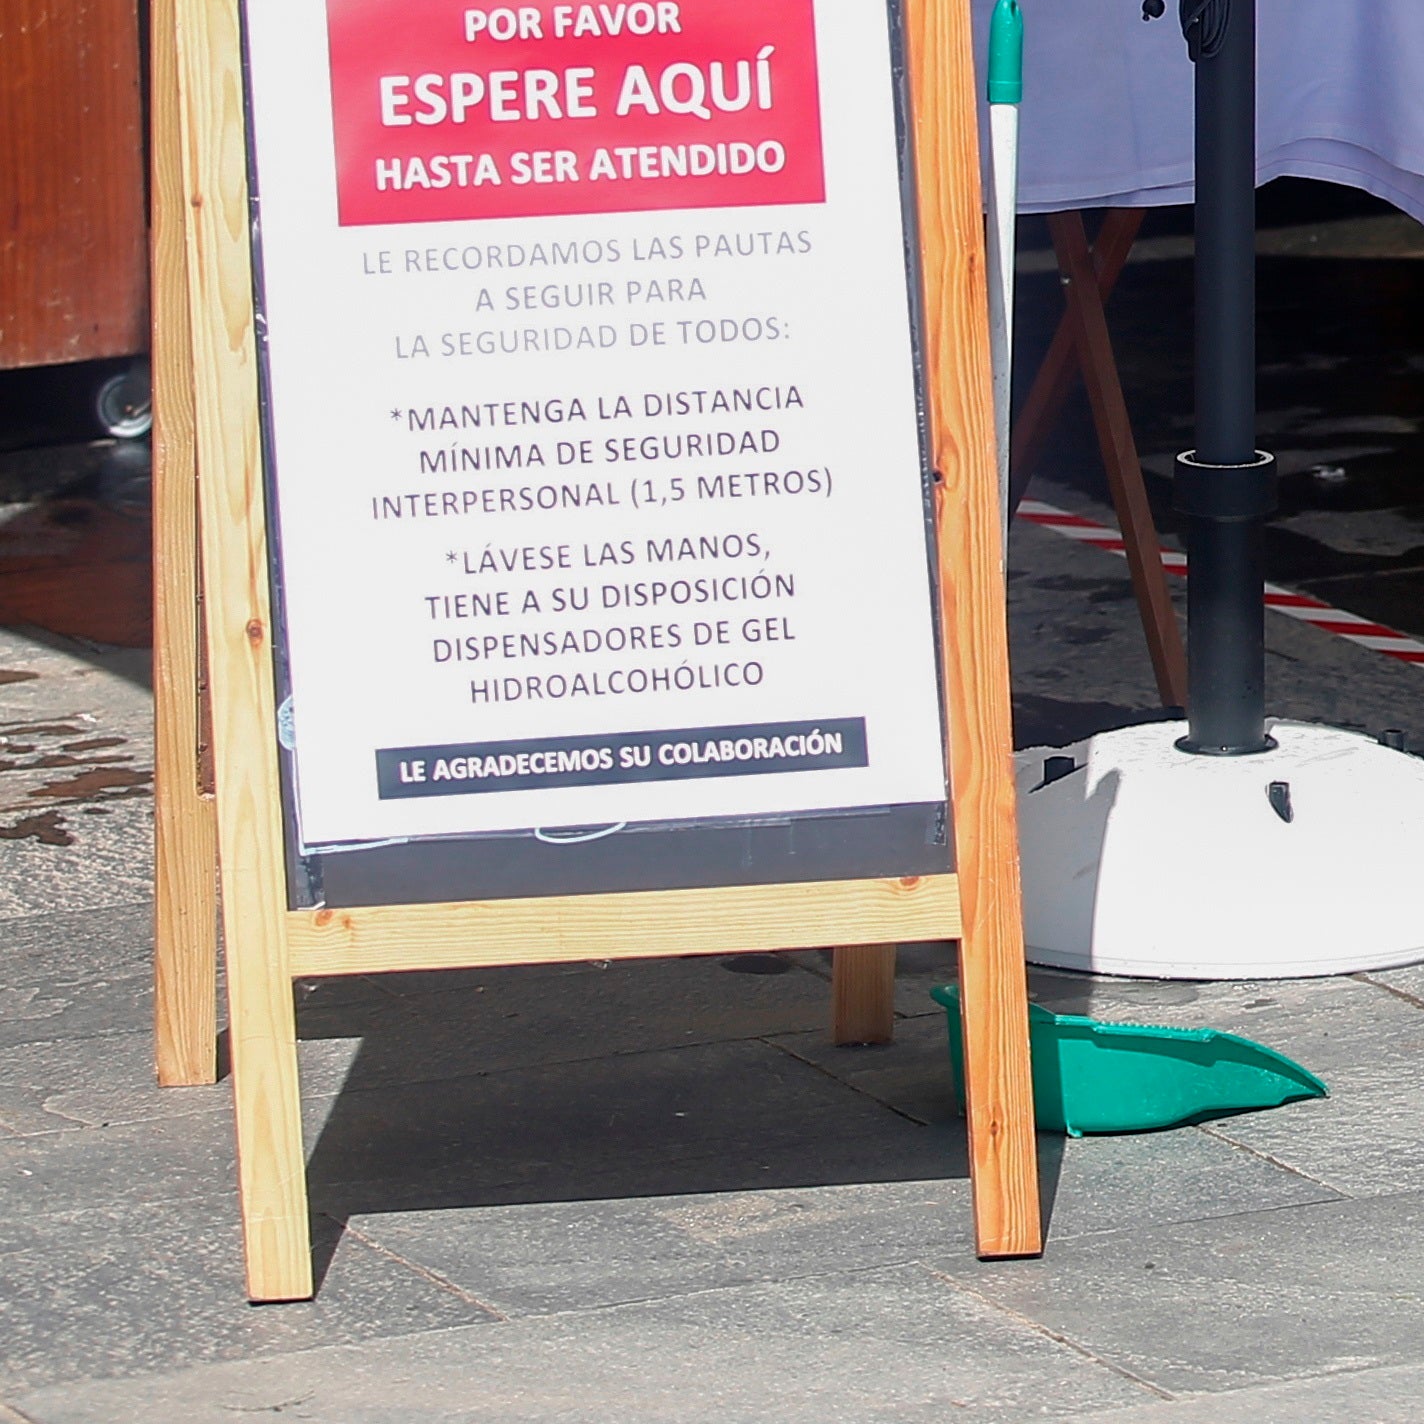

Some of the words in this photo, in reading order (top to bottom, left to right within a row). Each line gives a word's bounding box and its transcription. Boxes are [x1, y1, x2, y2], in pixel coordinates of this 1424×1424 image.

[465, 8, 542, 41] POR
[554, 2, 681, 37] FAVOR
[380, 68, 596, 125] ESPERE
[617, 46, 774, 119] AQUÍ
[376, 154, 501, 190] HASTA
[511, 151, 579, 184] SER
[590, 141, 784, 180] ATENDIDO
[363, 251, 392, 275] LE
[405, 239, 620, 272] RECORDAMOS
[633, 236, 683, 260] LAS
[696, 231, 811, 257] PAUTAS
[476, 288, 494, 311] A
[506, 282, 614, 310] SEGUIR
[627, 278, 706, 304] PARA
[396, 335, 430, 358] LA
[442, 325, 617, 356] SEGURIDAD
[630, 322, 666, 346] DE
[599, 396, 632, 419] LA
[644, 386, 803, 416] DISTANCIA
[420, 441, 545, 473] MÍNIMA
[557, 440, 593, 465] DE
[605, 430, 779, 462] SEGURIDAD
[373, 483, 620, 519] INTERPERSONAL
[631, 478, 684, 509] (1,5
[698, 467, 831, 499] METROS)
[584, 541, 634, 566] LAS
[647, 533, 769, 562] MANOS,
[425, 592, 509, 619] TIENE
[522, 590, 540, 613] A
[552, 587, 588, 612] SU
[602, 568, 794, 608] DISPOSICIÓN
[434, 624, 681, 662] DISPENSADORES
[694, 621, 730, 645] DE
[742, 617, 795, 642] GEL
[471, 660, 763, 703] HIDROALCOHÓLICO
[401, 761, 426, 782] LE
[433, 748, 613, 780] AGRADECEMOS
[620, 746, 650, 767] SU
[659, 730, 842, 765] COLABORACIÓN
